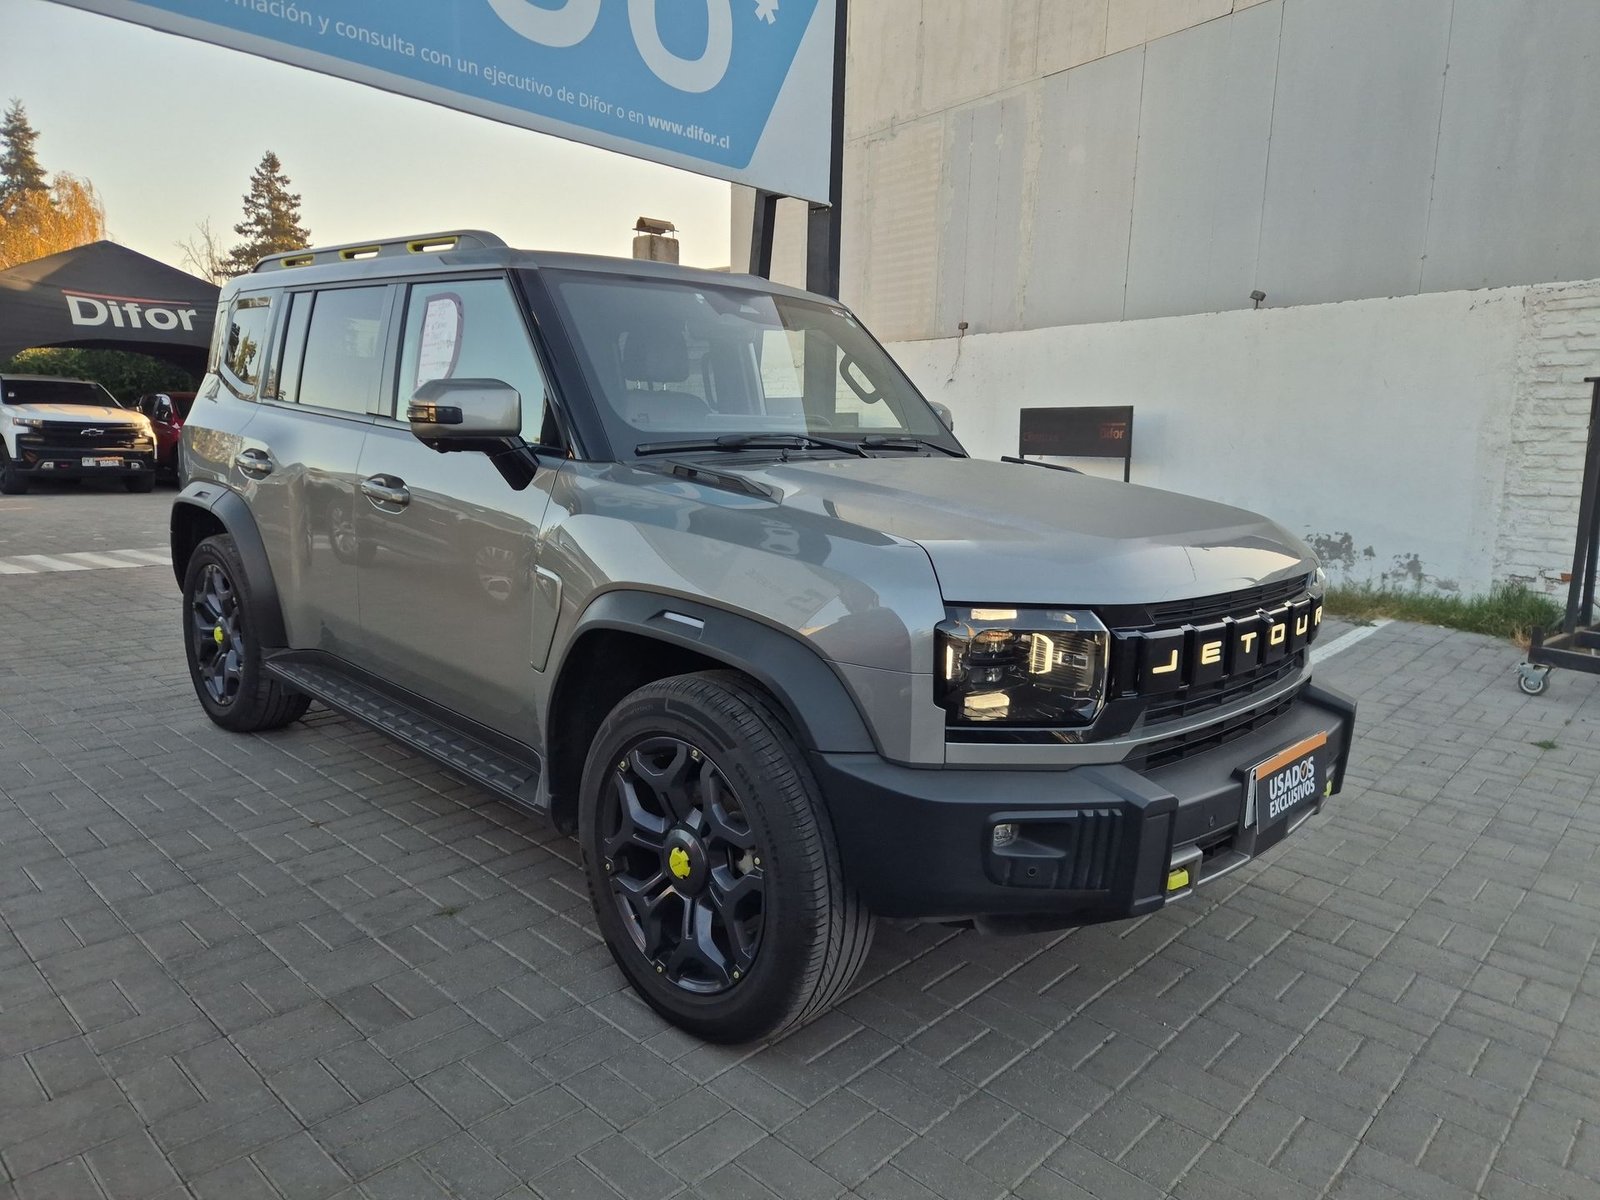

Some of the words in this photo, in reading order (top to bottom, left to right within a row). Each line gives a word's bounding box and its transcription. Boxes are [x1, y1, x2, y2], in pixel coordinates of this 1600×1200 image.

[318, 15, 330, 34] y
[335, 20, 415, 57] consulta
[421, 47, 452, 69] con
[457, 58, 479, 77] un
[483, 67, 553, 98] ejecutivo
[557, 86, 575, 105] de
[579, 92, 613, 116] Difor
[616, 107, 625, 120] o
[628, 110, 645, 125] en
[648, 114, 730, 150] www.difor.cl
[65, 296, 198, 331] Difor
[1152, 605, 1323, 674] JETOUR
[1269, 756, 1315, 800] USADOS
[1269, 777, 1316, 818] EXCLUSIVOS
